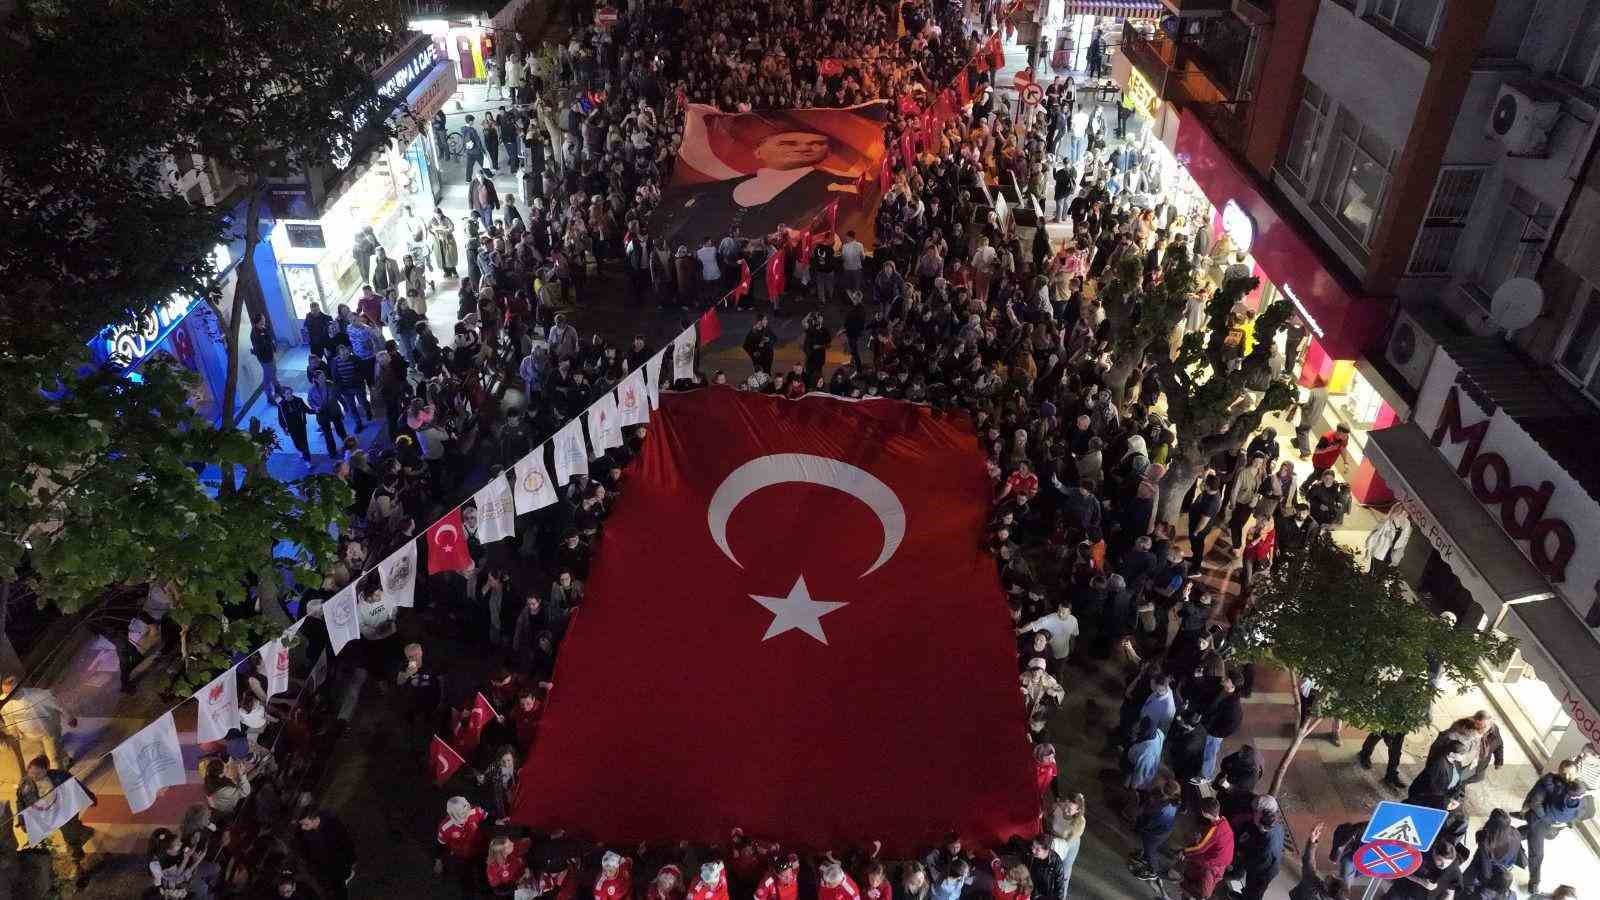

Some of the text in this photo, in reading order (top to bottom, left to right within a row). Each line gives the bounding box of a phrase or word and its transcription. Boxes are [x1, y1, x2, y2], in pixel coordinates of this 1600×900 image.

[1427, 385, 1575, 583] Moda
[1429, 525, 1453, 561] Park
[1561, 678, 1600, 745] Moda
